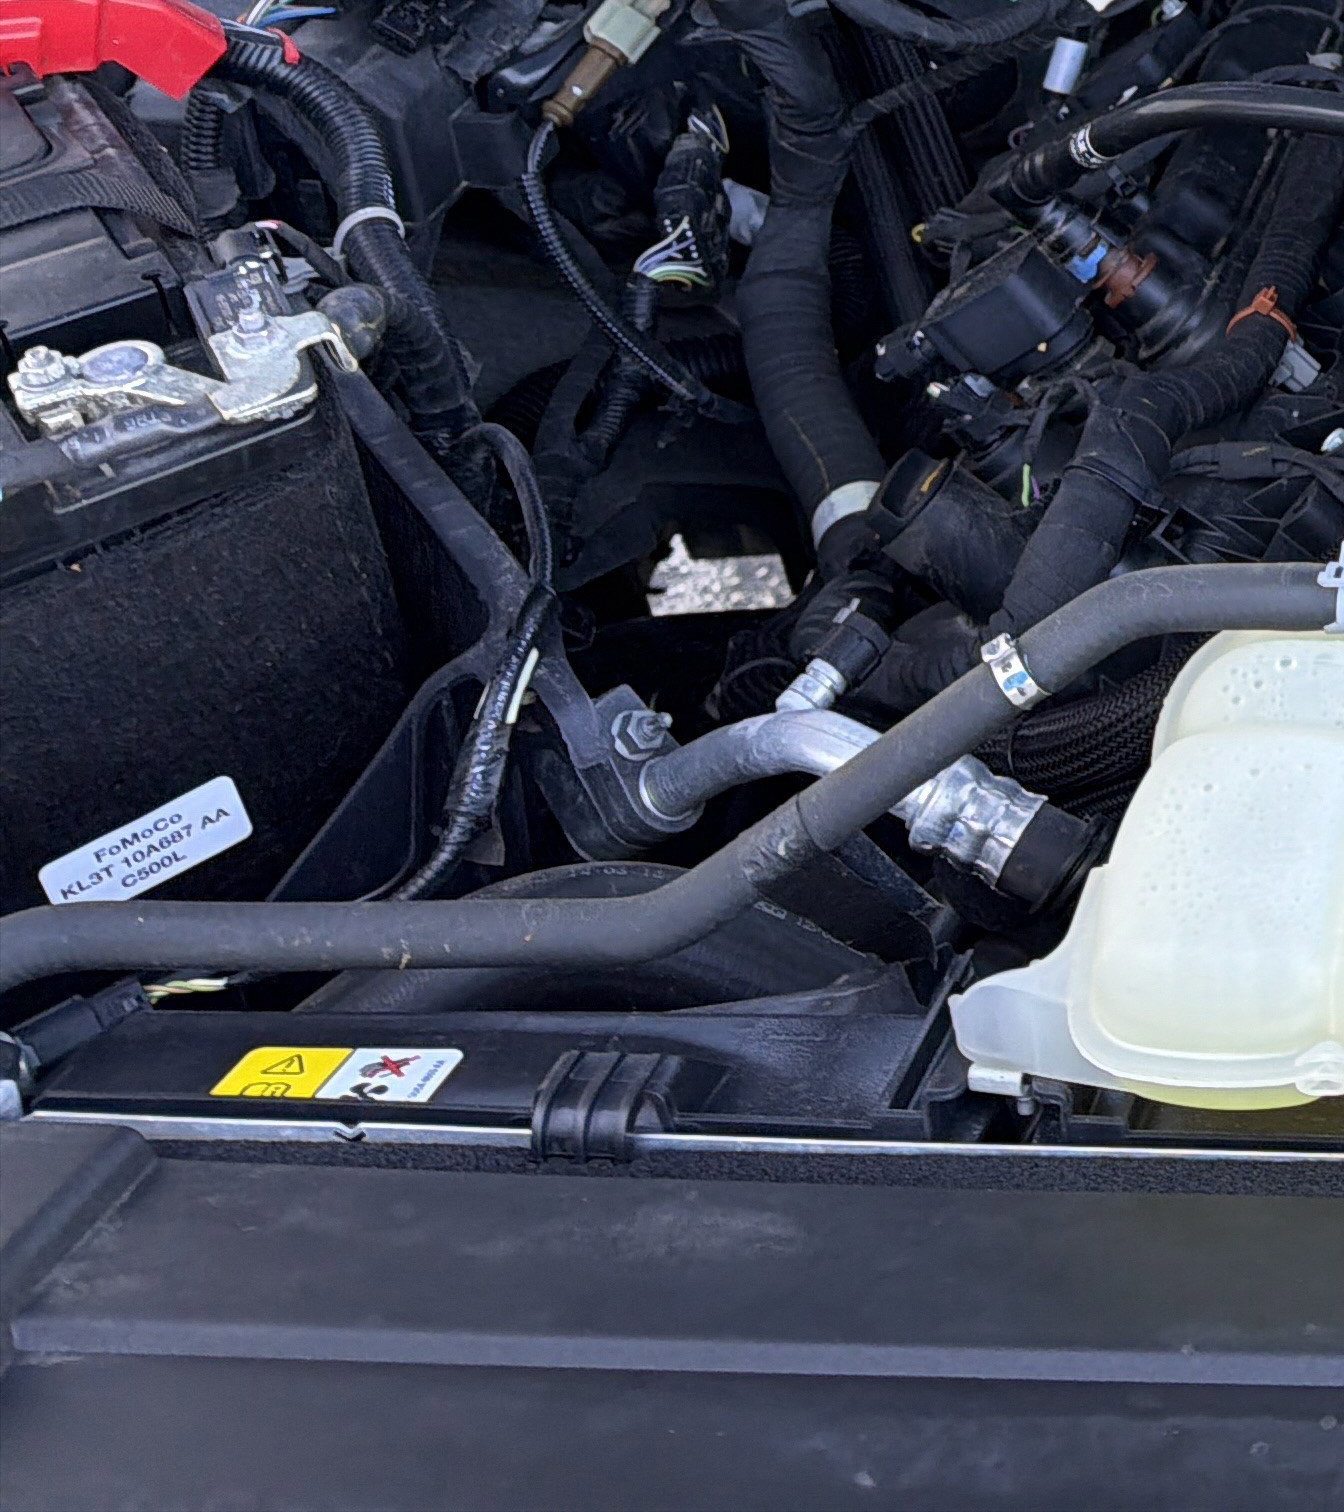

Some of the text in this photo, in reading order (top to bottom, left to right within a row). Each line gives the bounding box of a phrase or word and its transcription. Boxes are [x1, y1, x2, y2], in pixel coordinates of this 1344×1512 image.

[60, 862, 114, 901] KL3T
[200, 807, 231, 831] AA
[94, 812, 183, 863] FoMoCo
[120, 850, 188, 889] C500L
